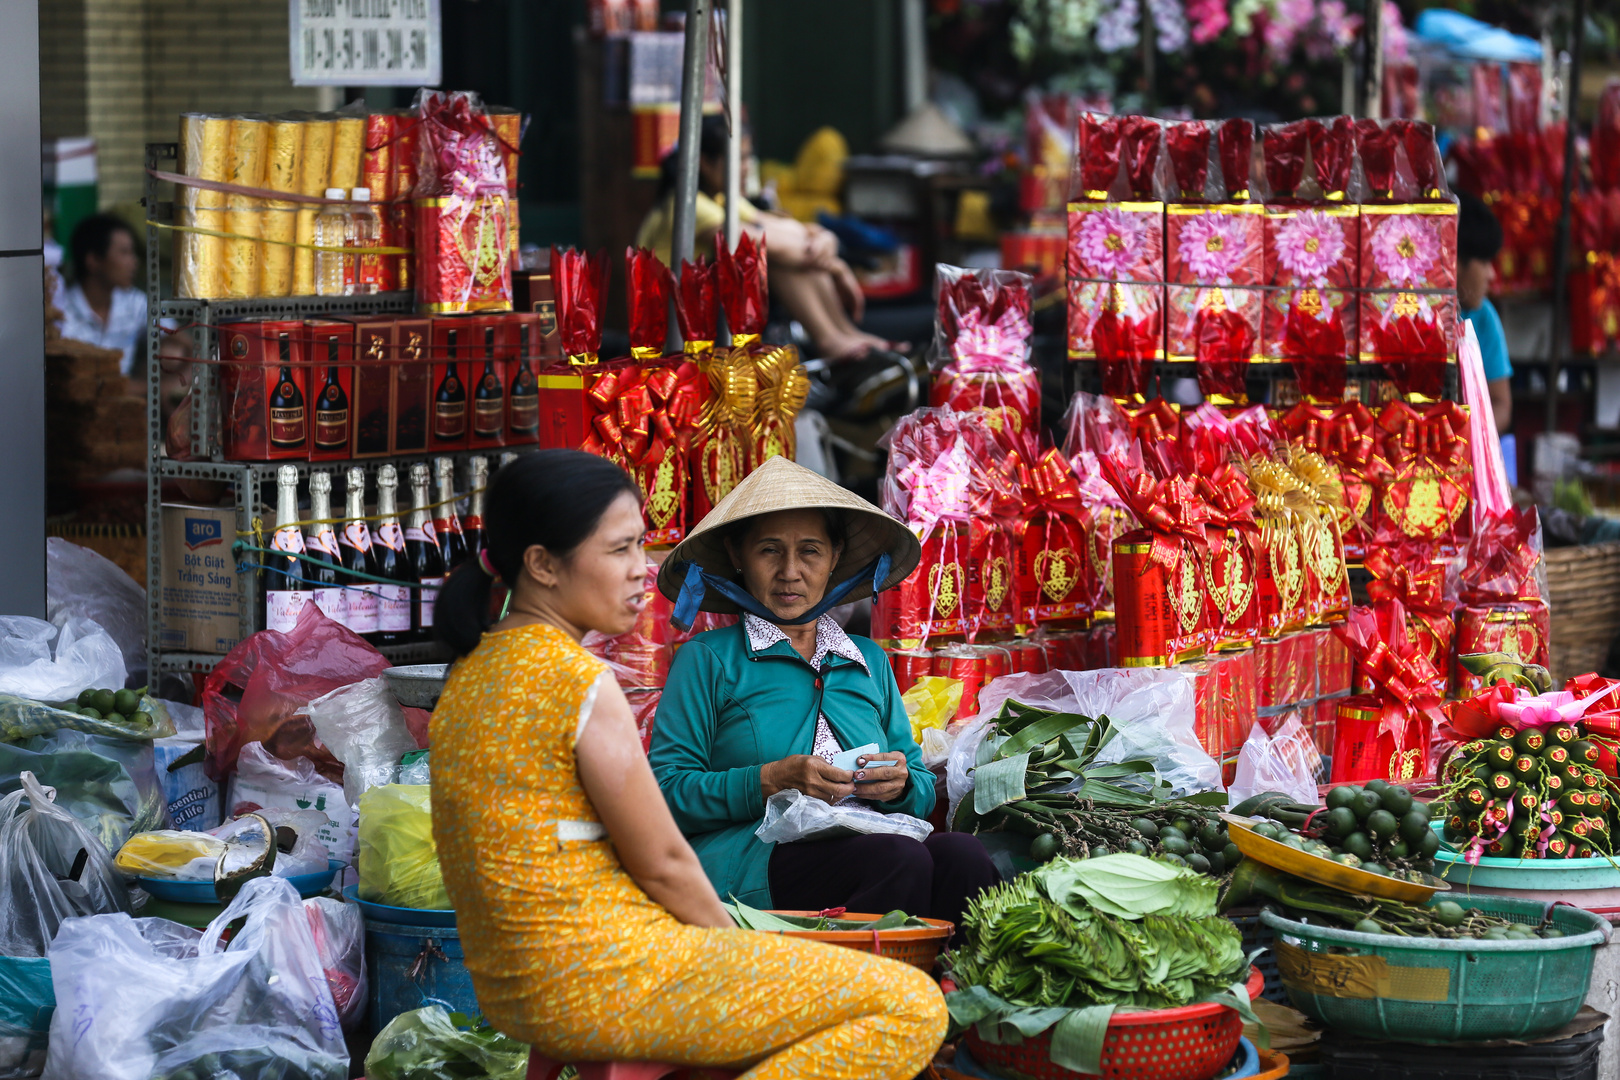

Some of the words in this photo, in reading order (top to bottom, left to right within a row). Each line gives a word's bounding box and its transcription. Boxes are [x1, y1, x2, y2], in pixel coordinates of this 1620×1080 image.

[192, 522, 215, 536] aro
[184, 554, 201, 569] Bột
[204, 556, 225, 570] Giặt
[168, 787, 207, 813] ssential
[175, 811, 186, 825] of
[184, 804, 204, 819] life
